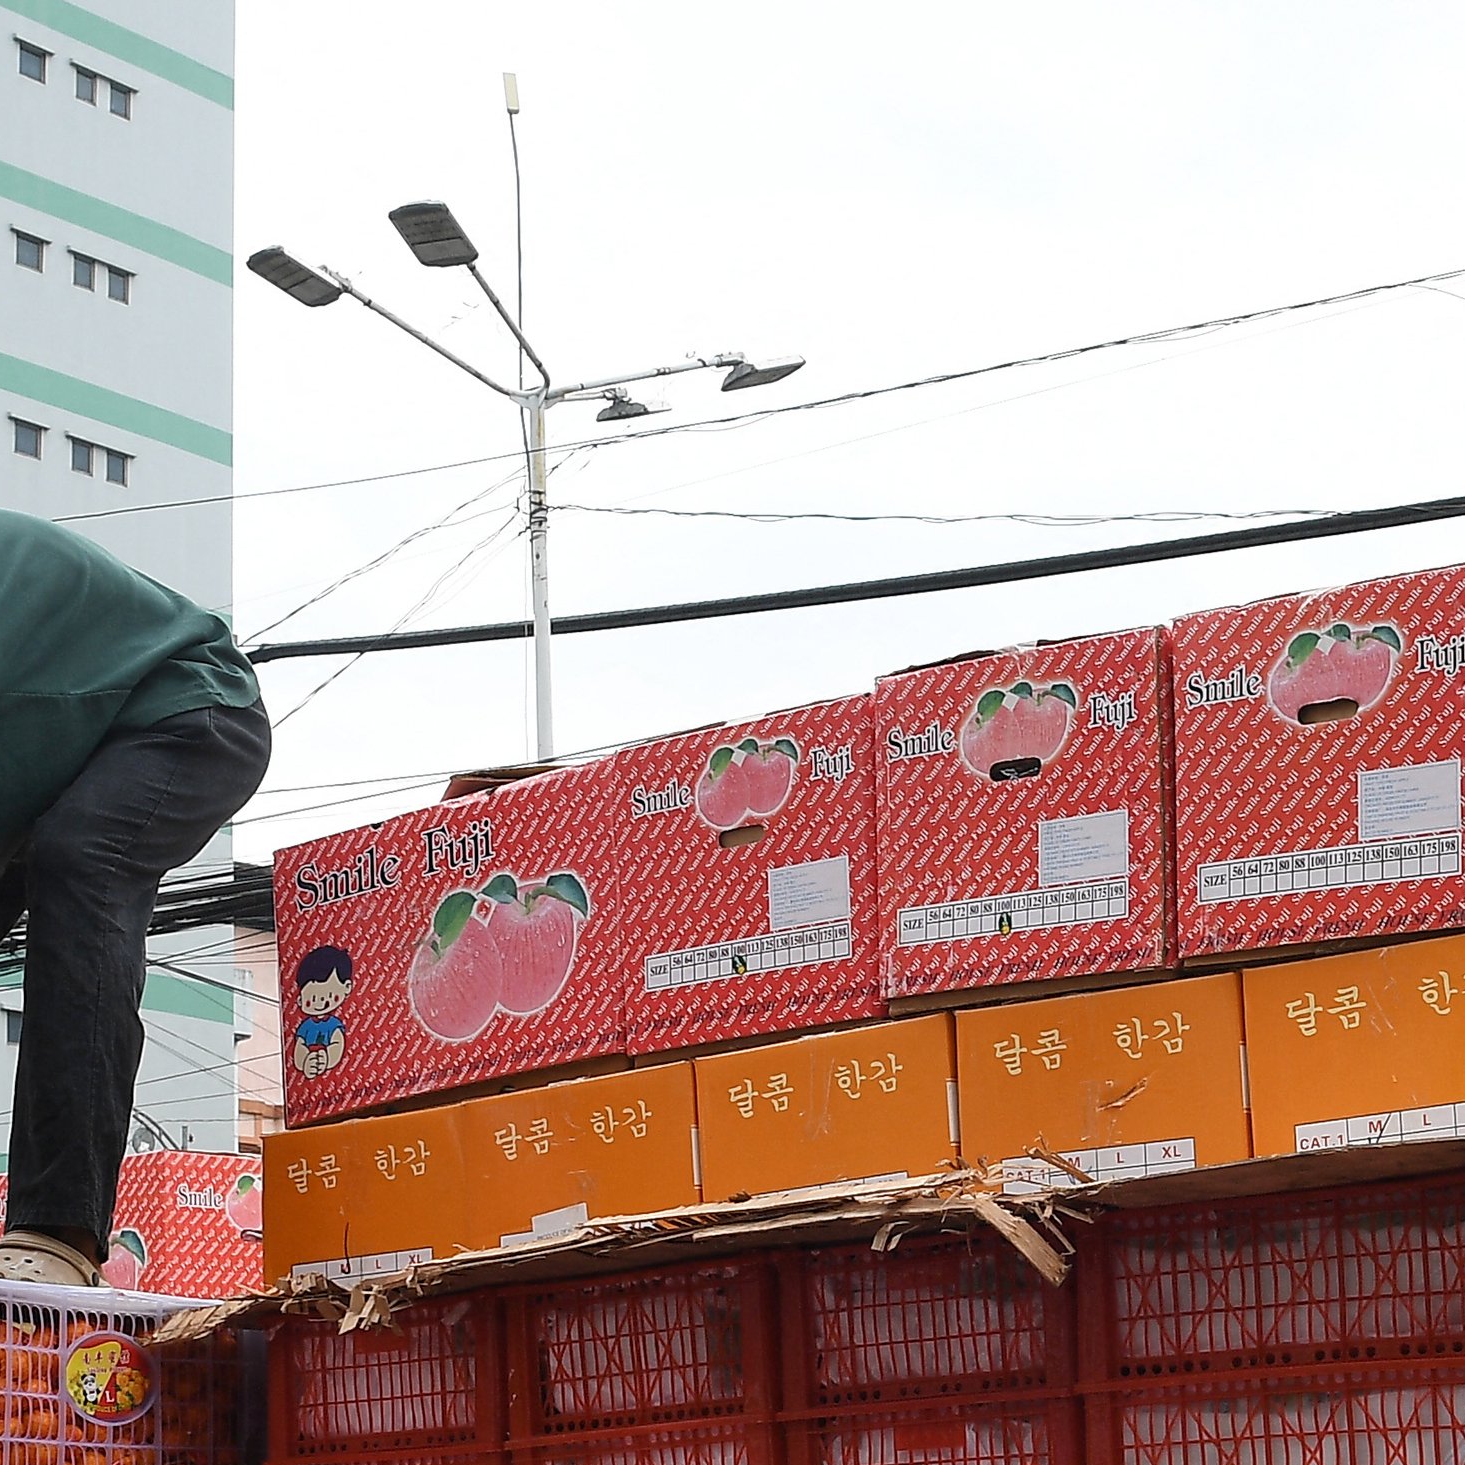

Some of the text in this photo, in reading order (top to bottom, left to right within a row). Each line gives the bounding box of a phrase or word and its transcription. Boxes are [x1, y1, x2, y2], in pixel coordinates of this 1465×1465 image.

[1185, 665, 1262, 708] Smile
[888, 691, 1136, 761] Smile Fuji
[631, 745, 854, 817] Smile Fuji
[296, 818, 495, 911] Smile Fuji
[1285, 985, 1367, 1037] 달콤
[993, 1012, 1190, 1076] 달콤 한감
[728, 1052, 903, 1119] 달콤 한감
[494, 1100, 653, 1161] 달콤 한감
[1116, 1152, 1124, 1163] L
[1162, 1146, 1181, 1158] XL
[1299, 1134, 1344, 1150] CAT.1
[1368, 1120, 1382, 1133] M
[1423, 1114, 1431, 1126] L
[287, 1140, 431, 1194] 달콤 한감
[177, 1183, 223, 1209] Smile
[376, 1253, 423, 1270] L XL
[106, 1391, 114, 1402] L
